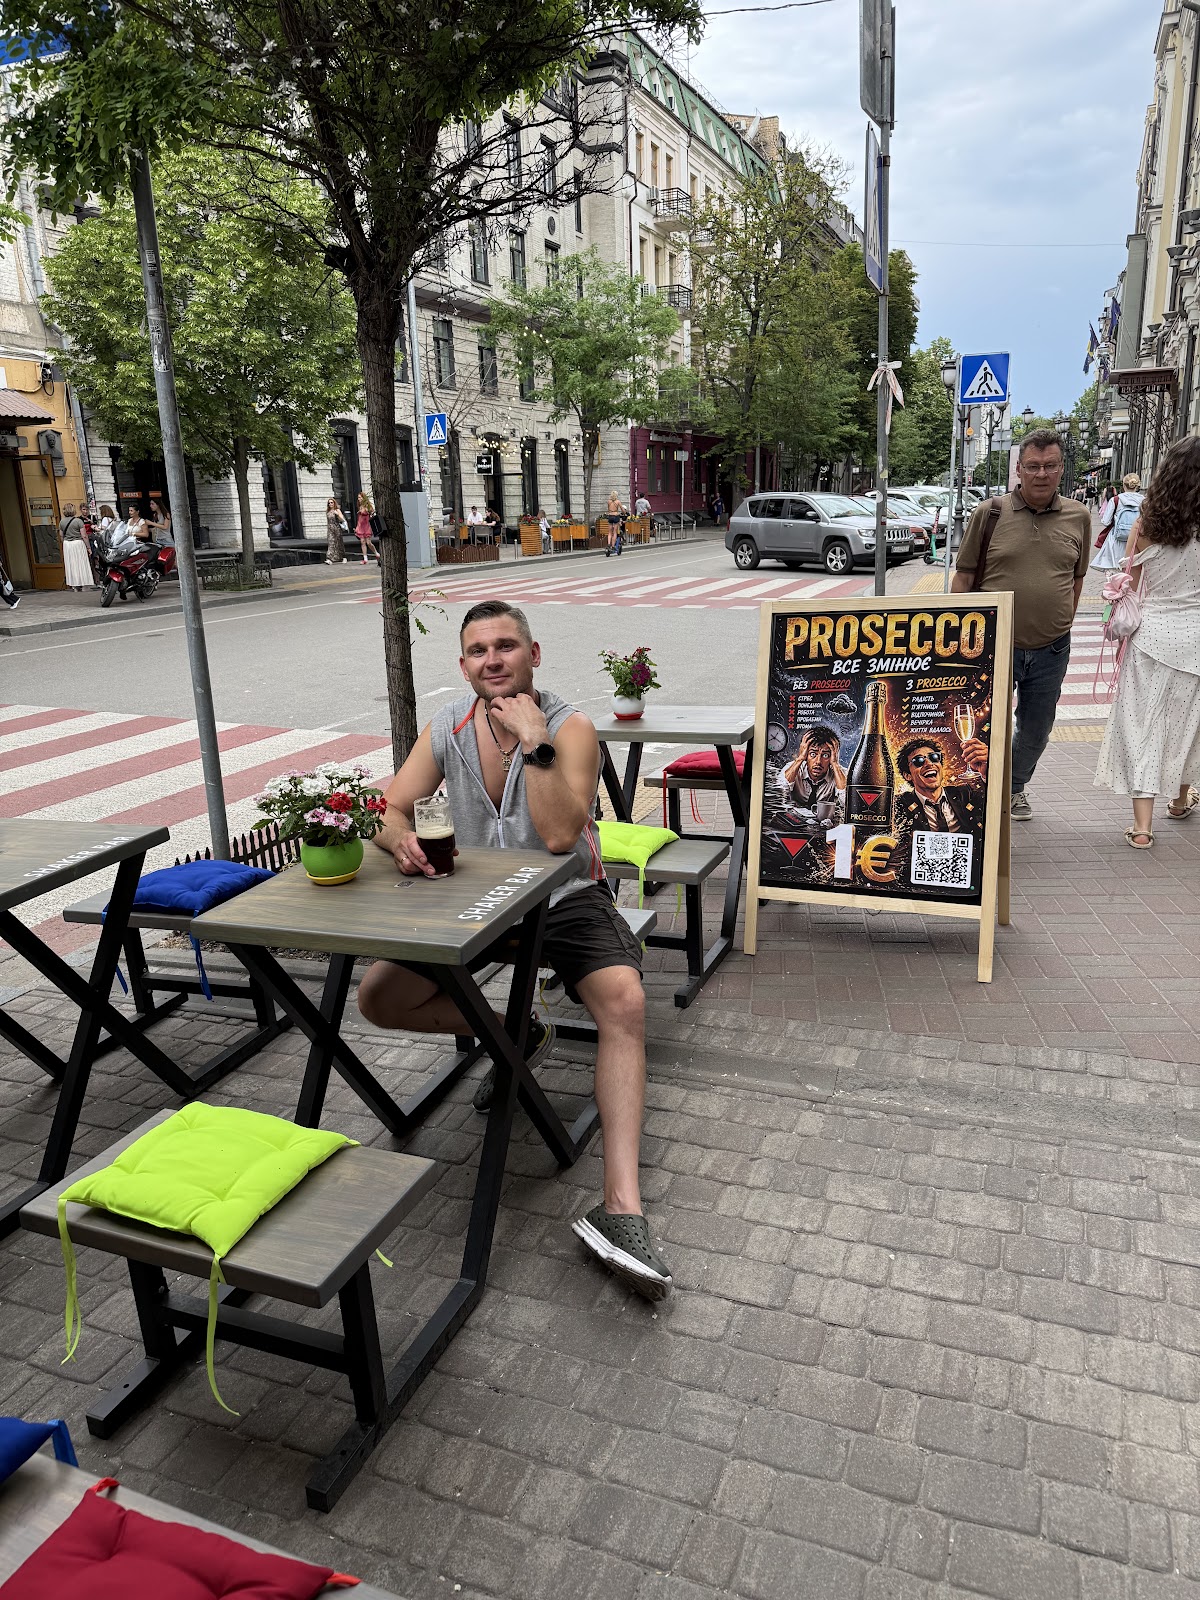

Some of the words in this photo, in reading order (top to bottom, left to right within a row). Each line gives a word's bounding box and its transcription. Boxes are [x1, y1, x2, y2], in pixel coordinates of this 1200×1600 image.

[784, 612, 986, 661] PROSECCO
[831, 658, 862, 675] ВСЕ
[866, 656, 932, 673] ЗМІНЮЄ
[792, 680, 809, 691] БЕЗ
[810, 679, 851, 689] PROSECCO
[916, 675, 967, 689] PROSECCO
[911, 695, 935, 703] РАДІСТЬ
[910, 711, 946, 719] ВІДПОЧИНОК
[850, 812, 887, 822] PROSECCO
[23, 850, 99, 878] SHAKER
[91, 836, 135, 850] BAR
[457, 885, 521, 921] SHAKER
[504, 866, 545, 884] BAR
